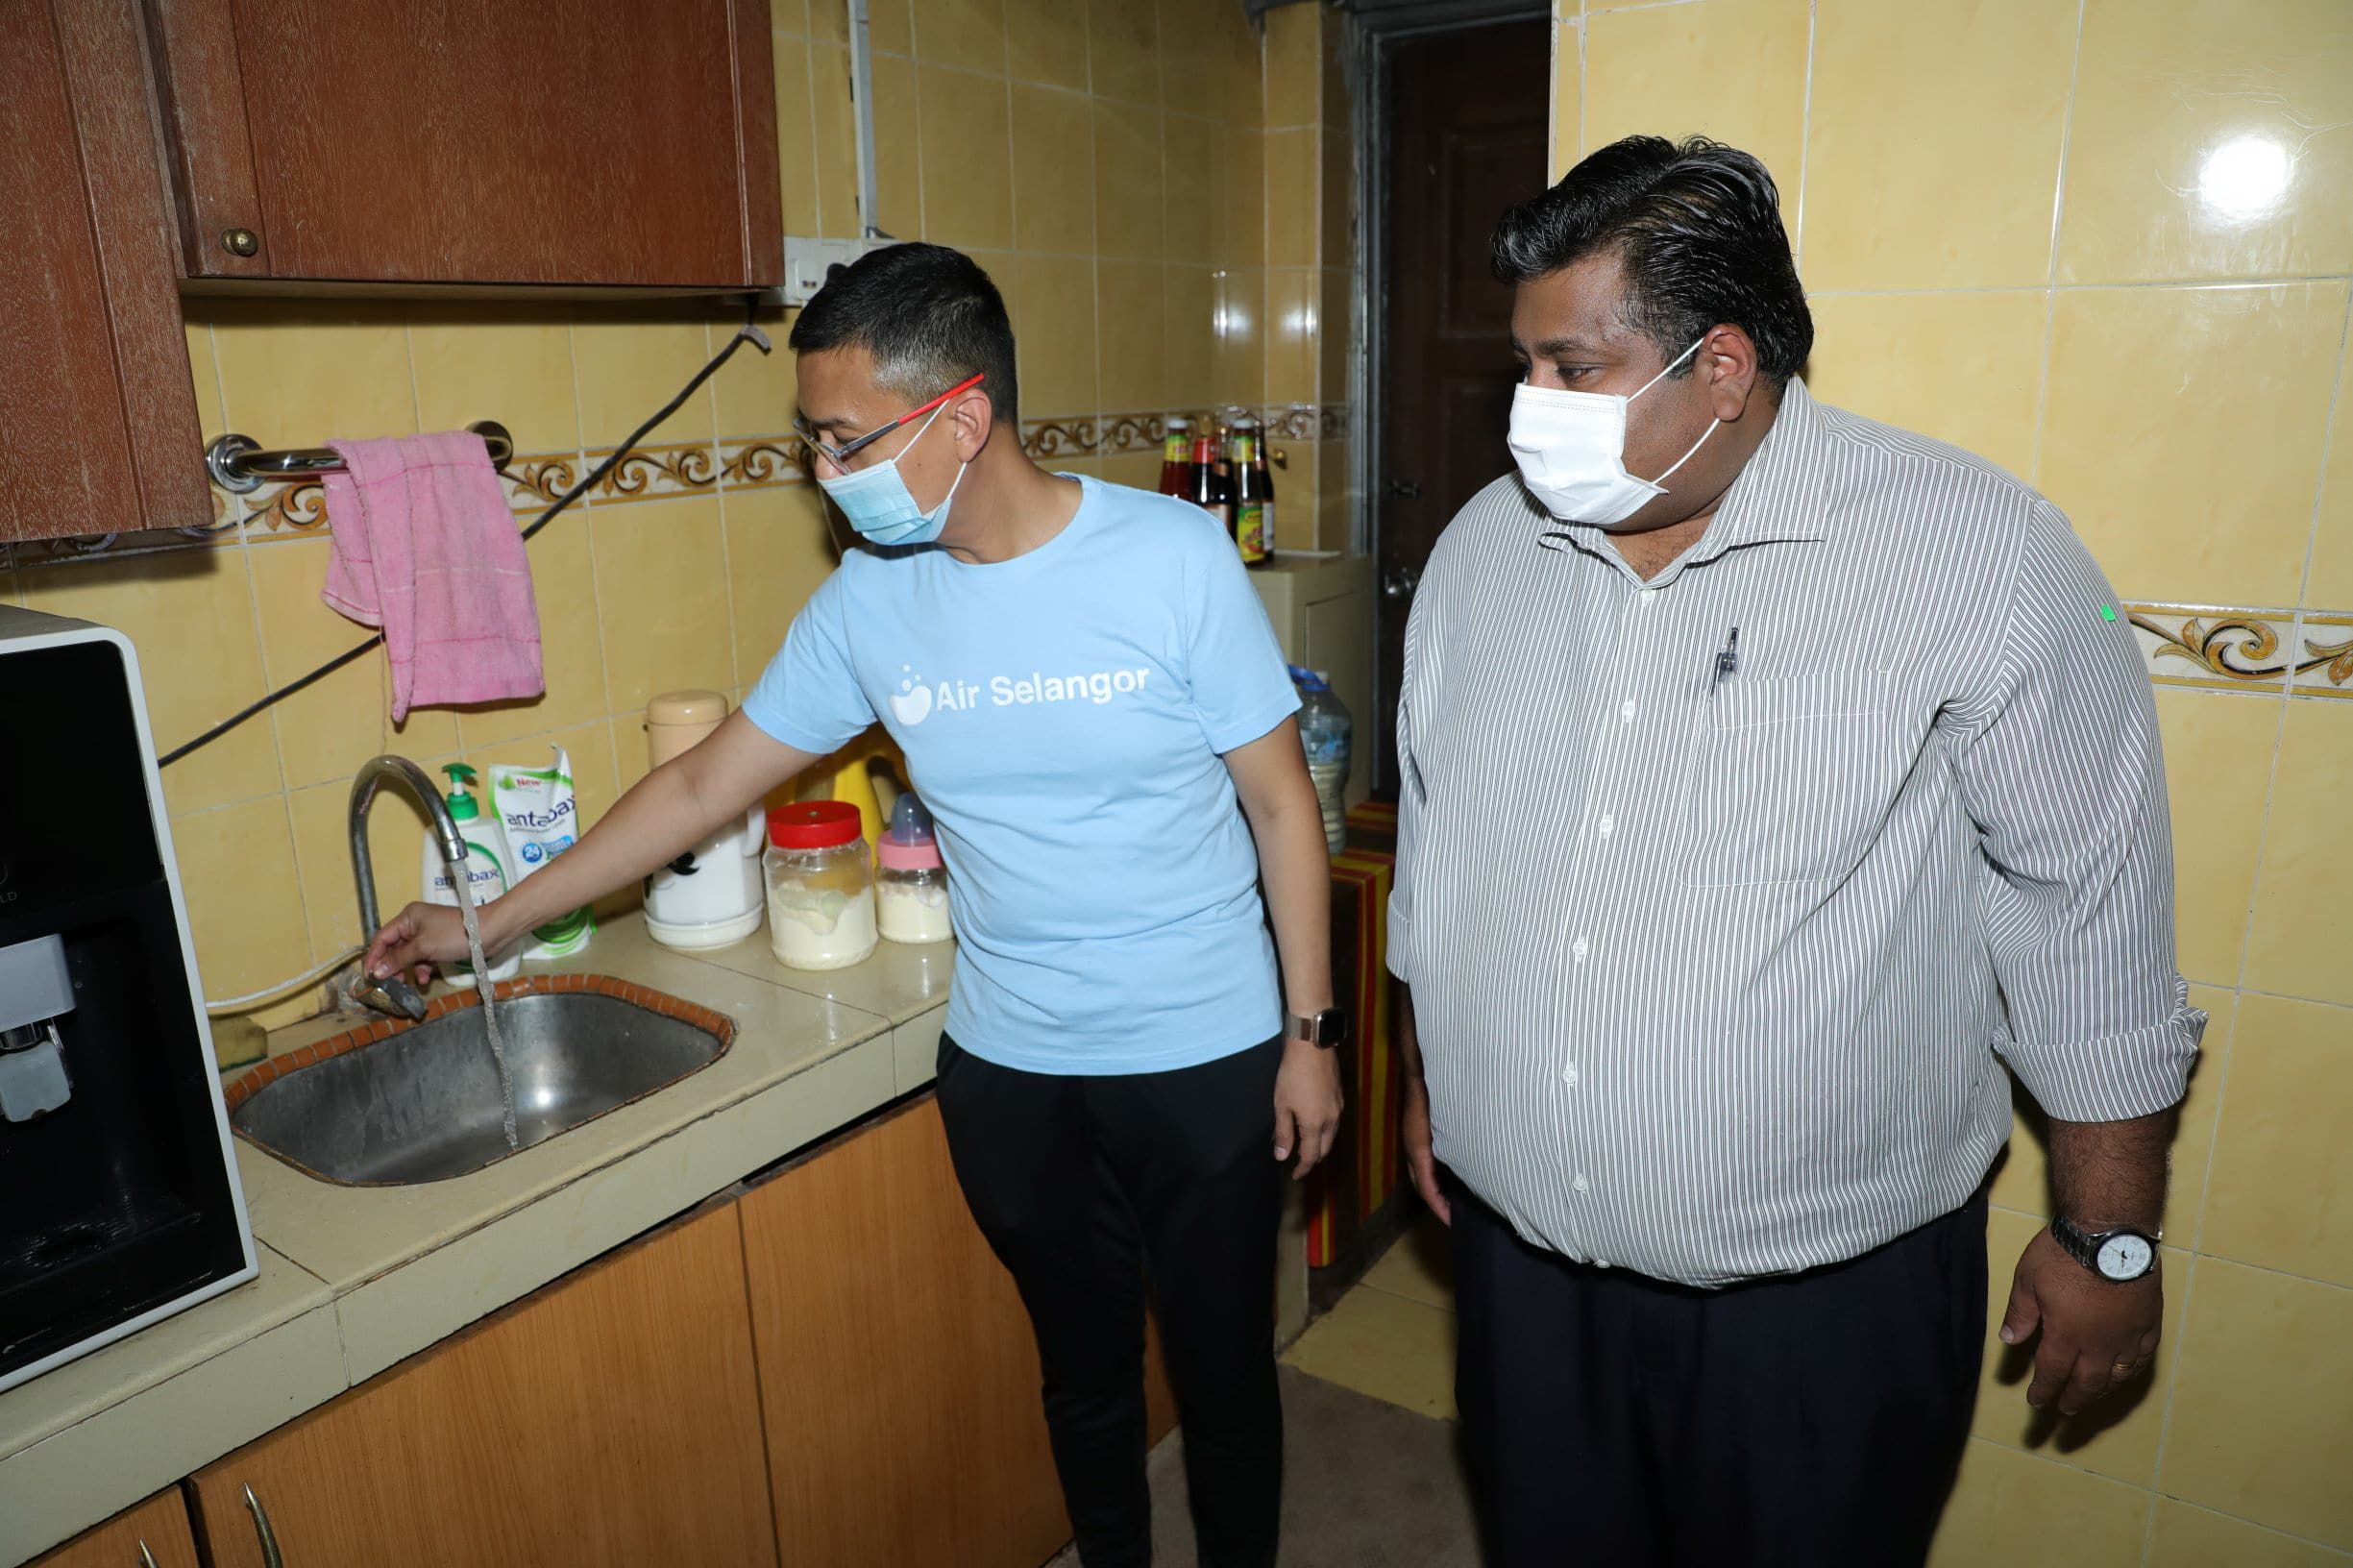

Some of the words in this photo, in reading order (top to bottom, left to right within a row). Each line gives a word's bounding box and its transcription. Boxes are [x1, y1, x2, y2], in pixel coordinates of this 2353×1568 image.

[936, 680, 980, 712] Air
[990, 668, 1150, 706] Selangor
[517, 777, 542, 787] New
[434, 868, 499, 886] anbax
